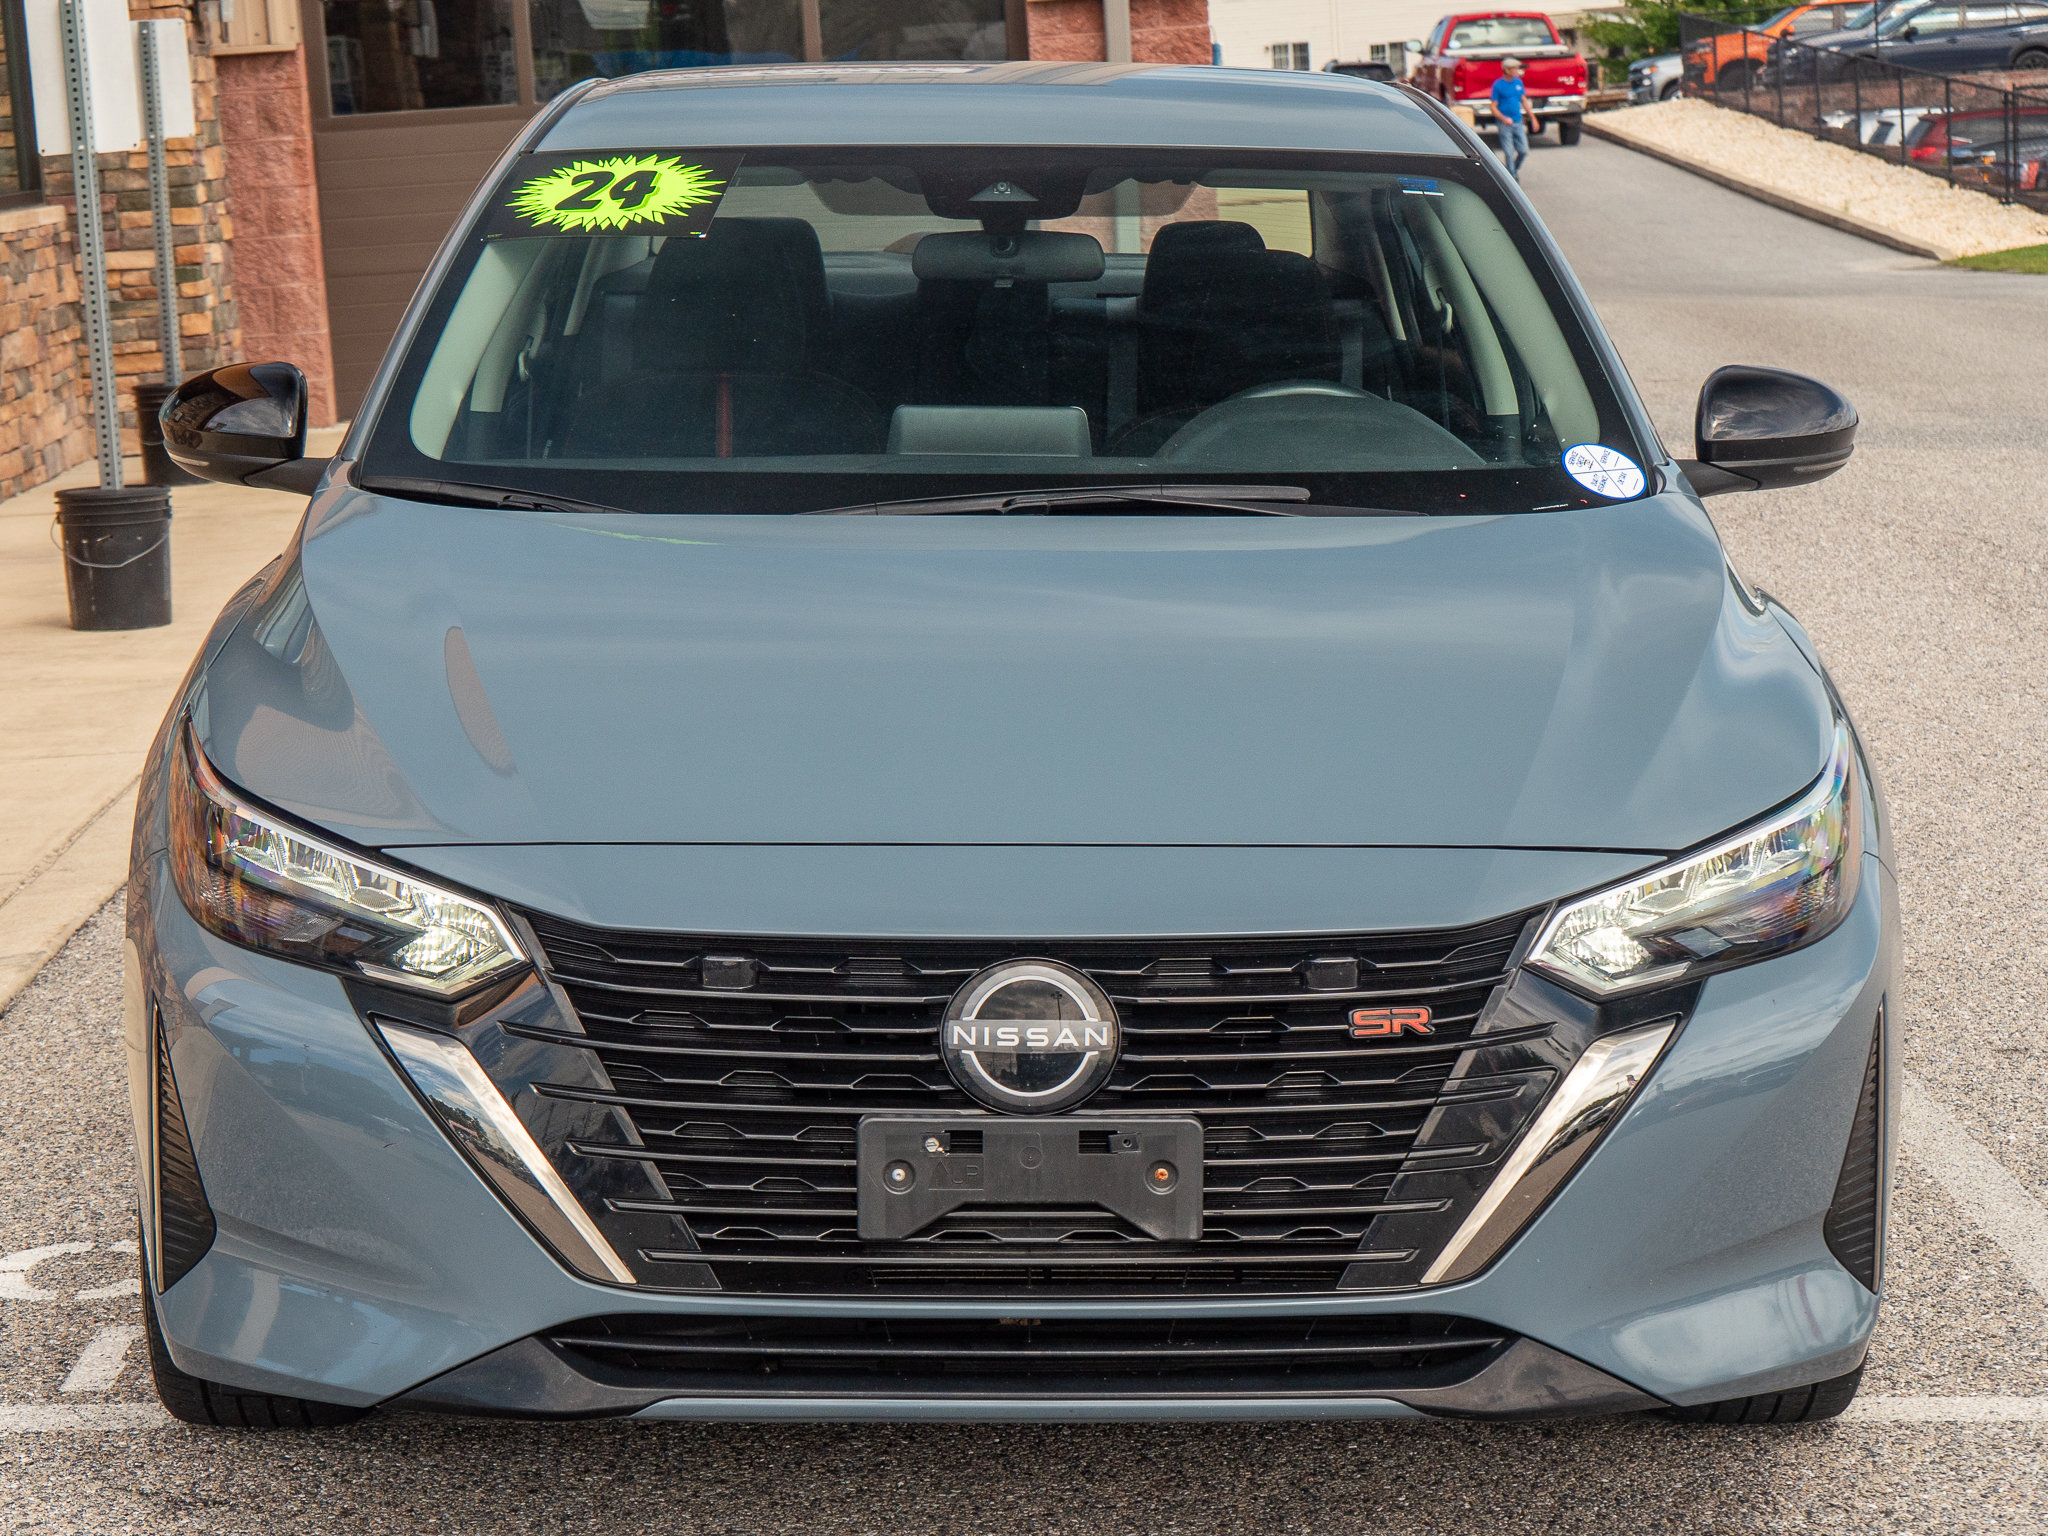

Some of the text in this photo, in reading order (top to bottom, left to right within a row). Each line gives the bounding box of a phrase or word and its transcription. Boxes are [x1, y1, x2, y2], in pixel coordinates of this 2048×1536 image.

[554, 170, 660, 212] 24
[952, 1025, 1108, 1047] NISSAN
[1350, 1007, 1433, 1037] SR
